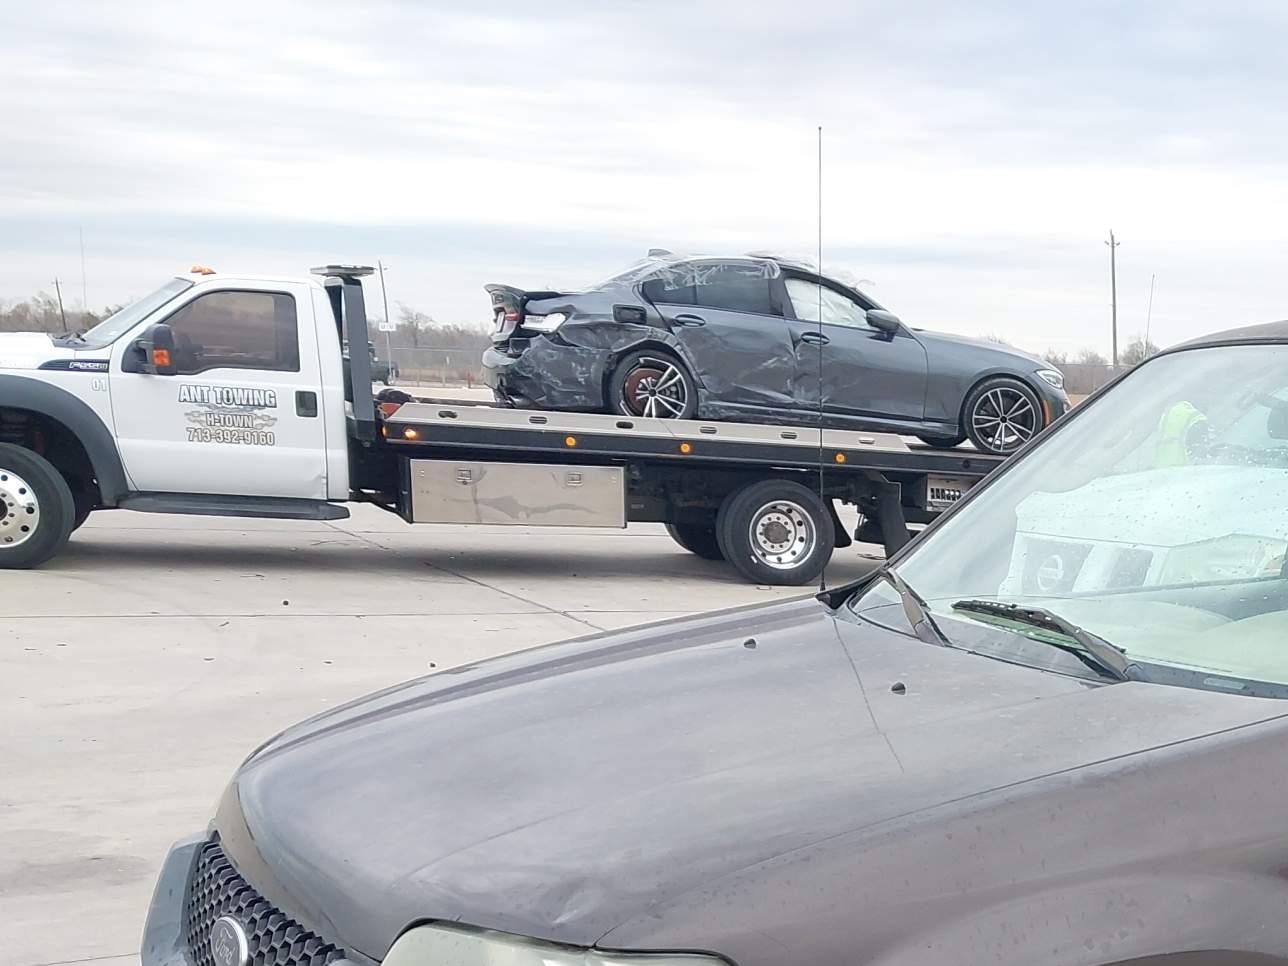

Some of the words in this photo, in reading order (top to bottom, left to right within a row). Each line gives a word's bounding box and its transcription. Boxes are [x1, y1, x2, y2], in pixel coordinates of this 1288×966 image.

[178, 384, 210, 403] ANT
[213, 386, 277, 408] TOWING
[205, 411, 254, 428] H-TOWN
[186, 427, 275, 446] 713-392-9160
[215, 926, 236, 966] Ford
